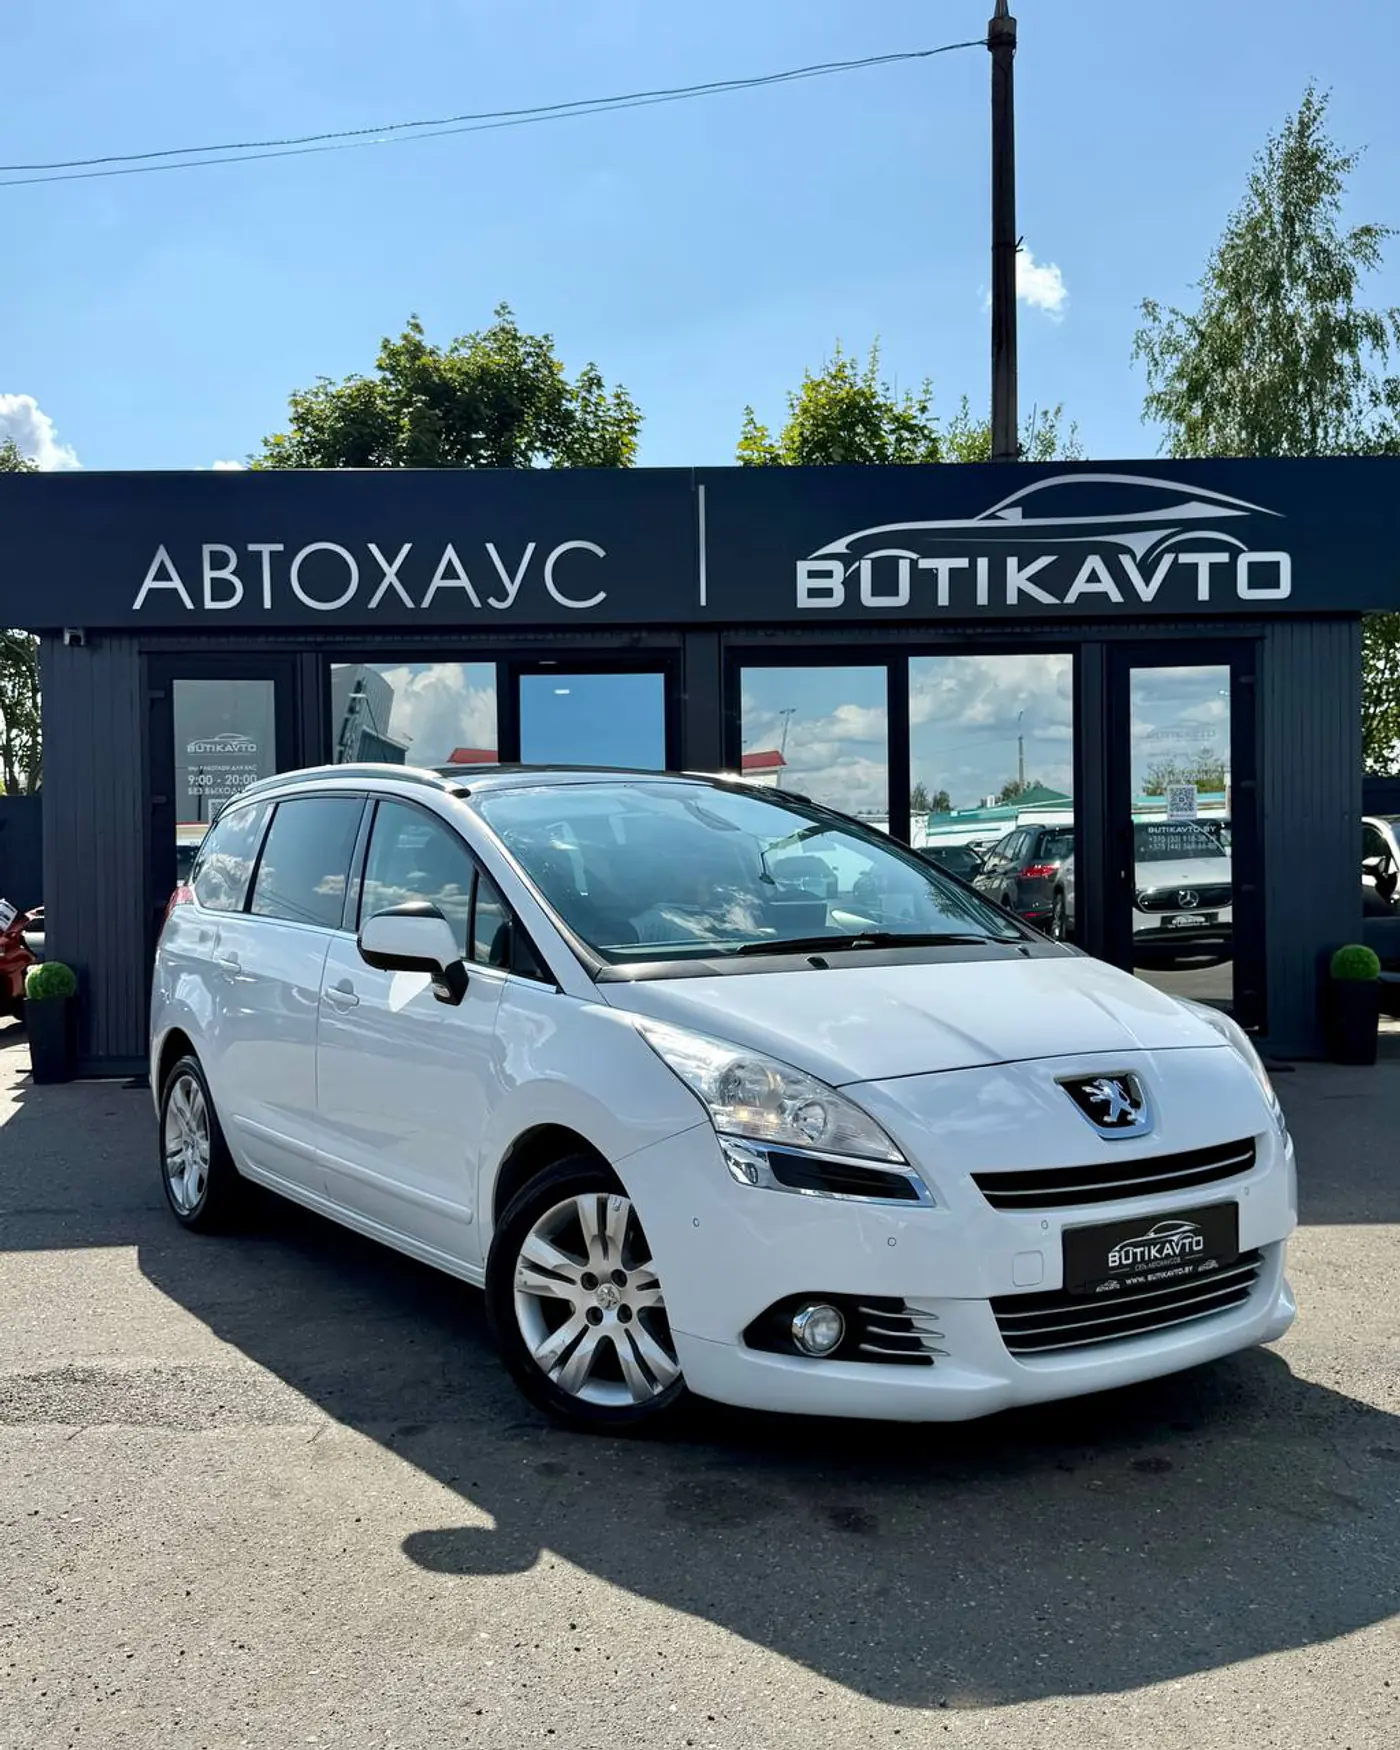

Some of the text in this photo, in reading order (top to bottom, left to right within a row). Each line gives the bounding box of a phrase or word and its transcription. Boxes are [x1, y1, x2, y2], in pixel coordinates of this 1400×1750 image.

[132, 540, 608, 611] АВТОХАУС
[796, 550, 1292, 609] BUTIKAVTO
[187, 743, 257, 753] BUTIKAVTO
[187, 774, 213, 786] 9:00
[225, 773, 257, 785] 20:00
[1108, 1236, 1204, 1267] BUTIKAVTO
